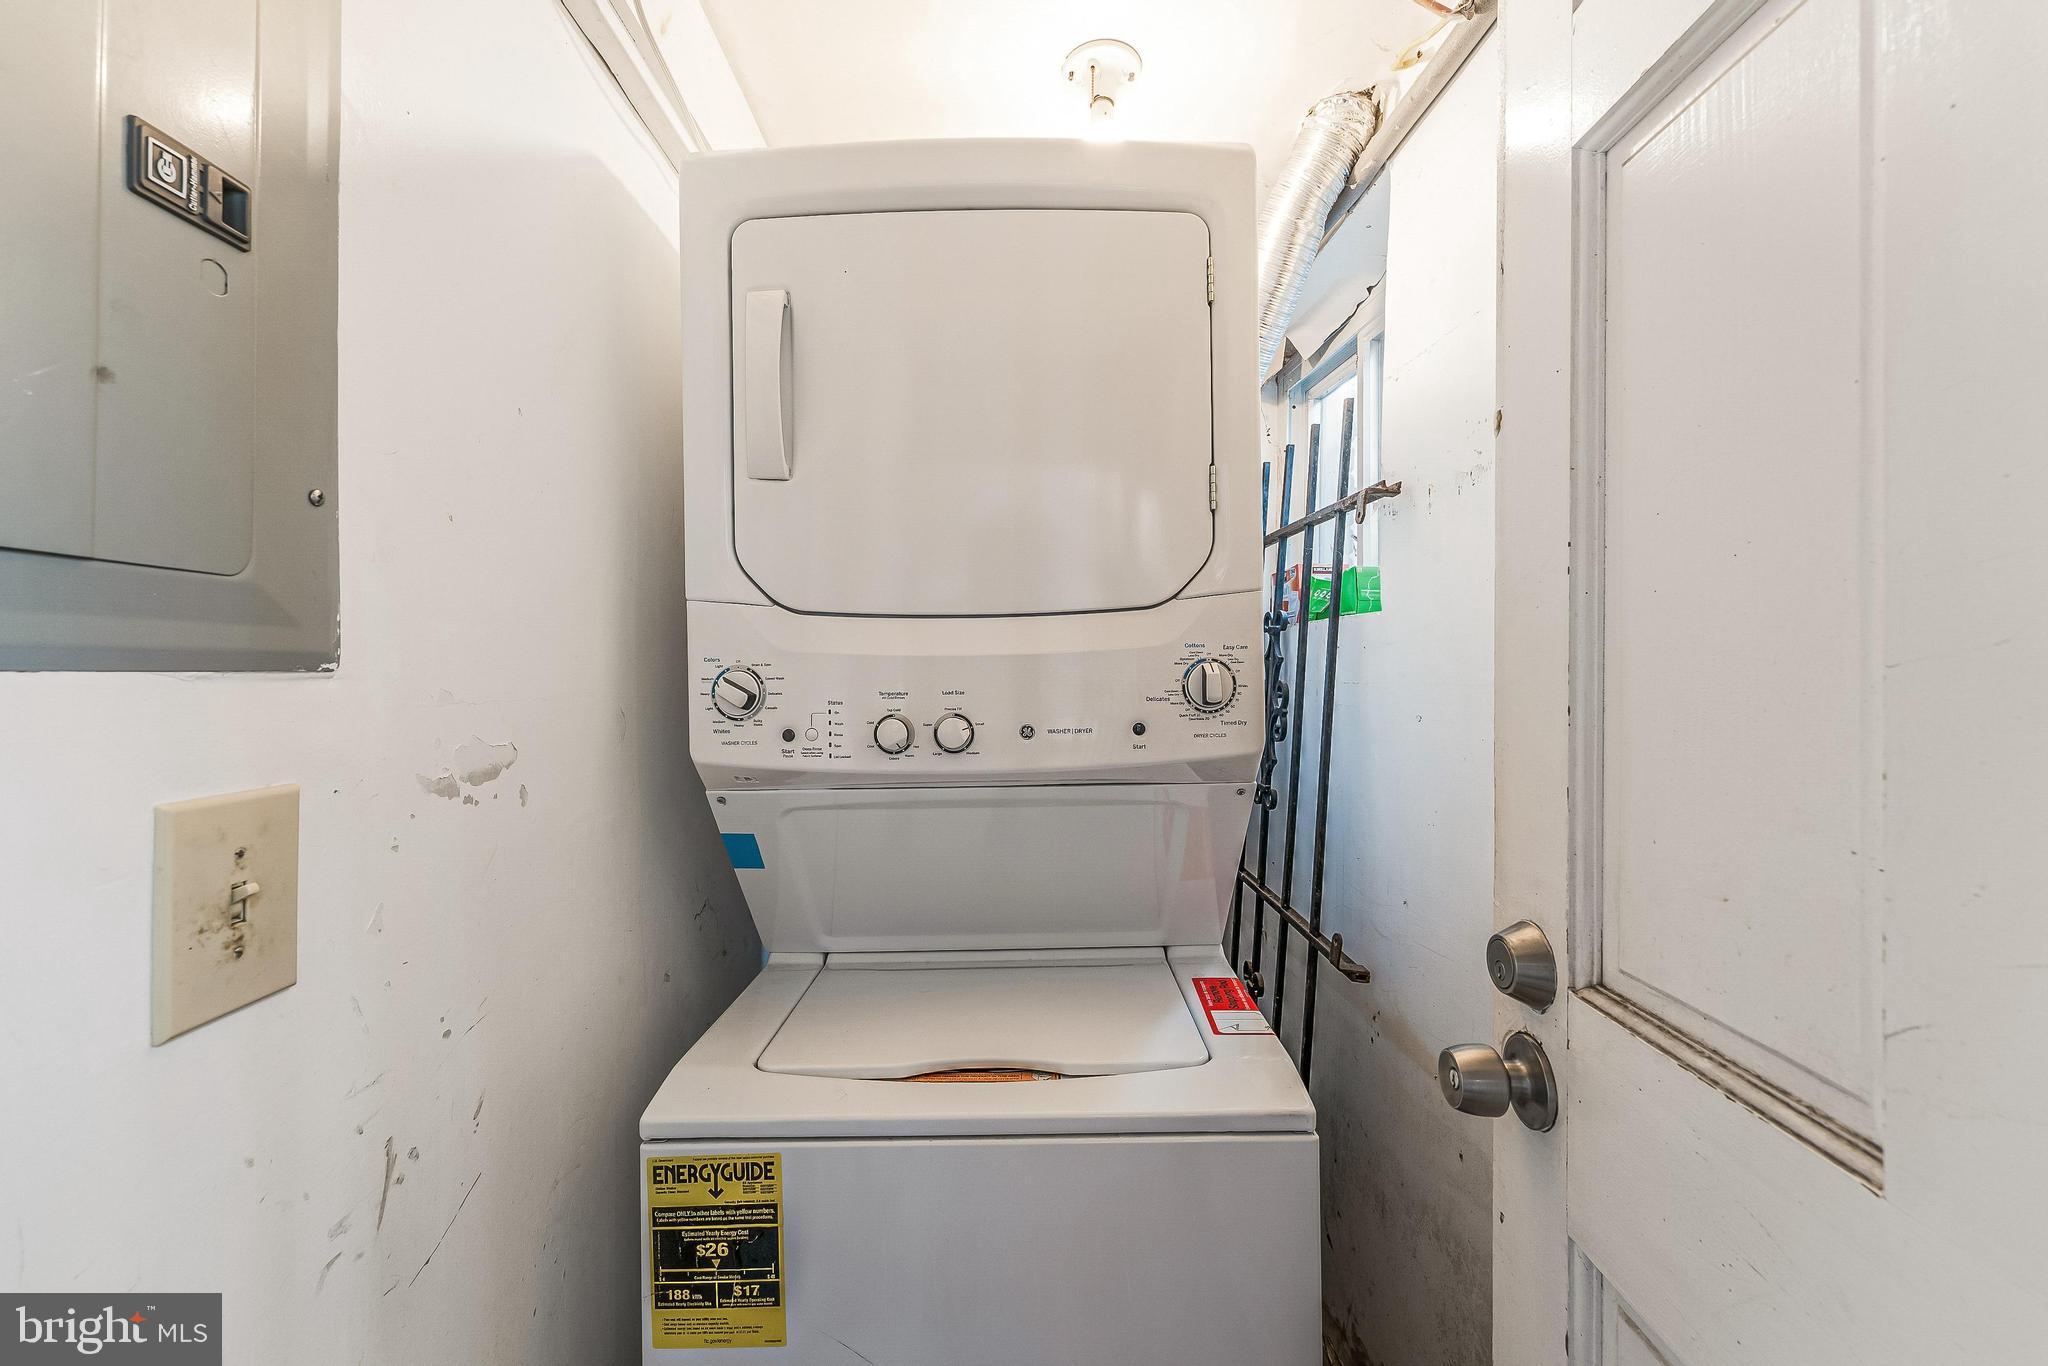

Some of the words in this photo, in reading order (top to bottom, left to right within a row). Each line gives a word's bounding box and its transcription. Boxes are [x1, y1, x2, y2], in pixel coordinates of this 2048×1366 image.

[653, 1161, 775, 1185] ENERGYGUIDE
[654, 1211, 676, 1219] Compare
[705, 1230, 720, 1238] Yearly
[696, 1243, 729, 1257] $26
[666, 1289, 691, 1301] 188
[733, 1285, 760, 1297] $17
